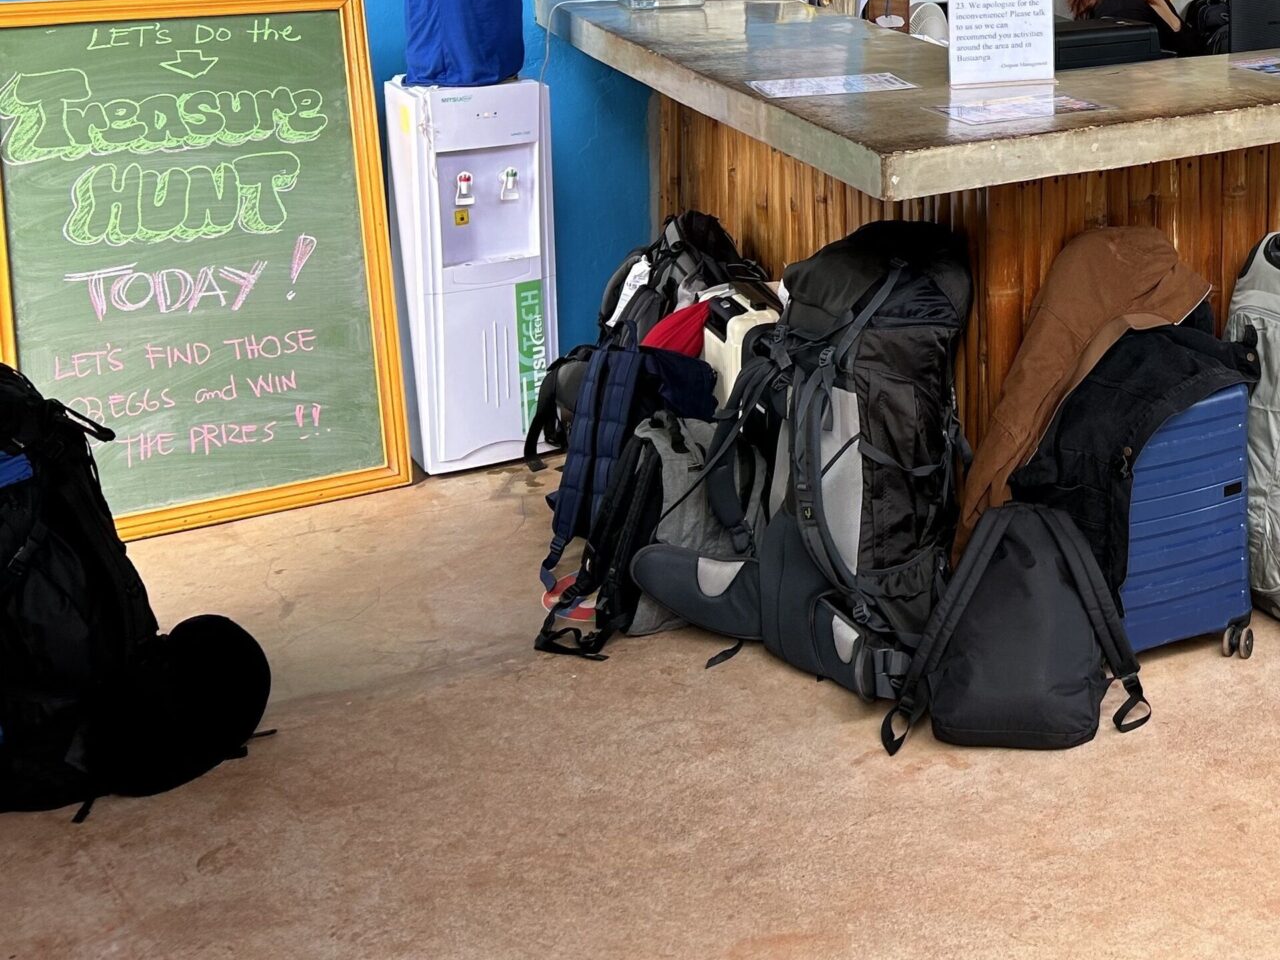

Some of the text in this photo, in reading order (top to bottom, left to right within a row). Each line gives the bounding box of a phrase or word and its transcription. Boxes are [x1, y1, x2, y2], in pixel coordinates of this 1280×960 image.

[956, 11, 1008, 20] inconvenience!
[982, 0, 1015, 10] apologize
[247, 18, 302, 43] the
[956, 33, 997, 41] recommend
[63, 151, 300, 247] HUNT
[63, 260, 268, 321] TODAY
[55, 329, 316, 380] LET'S FIND THOSE
[195, 375, 237, 404] and
[247, 370, 296, 398] WIN
[115, 432, 176, 468] THE
[189, 421, 277, 455] PRIZES
